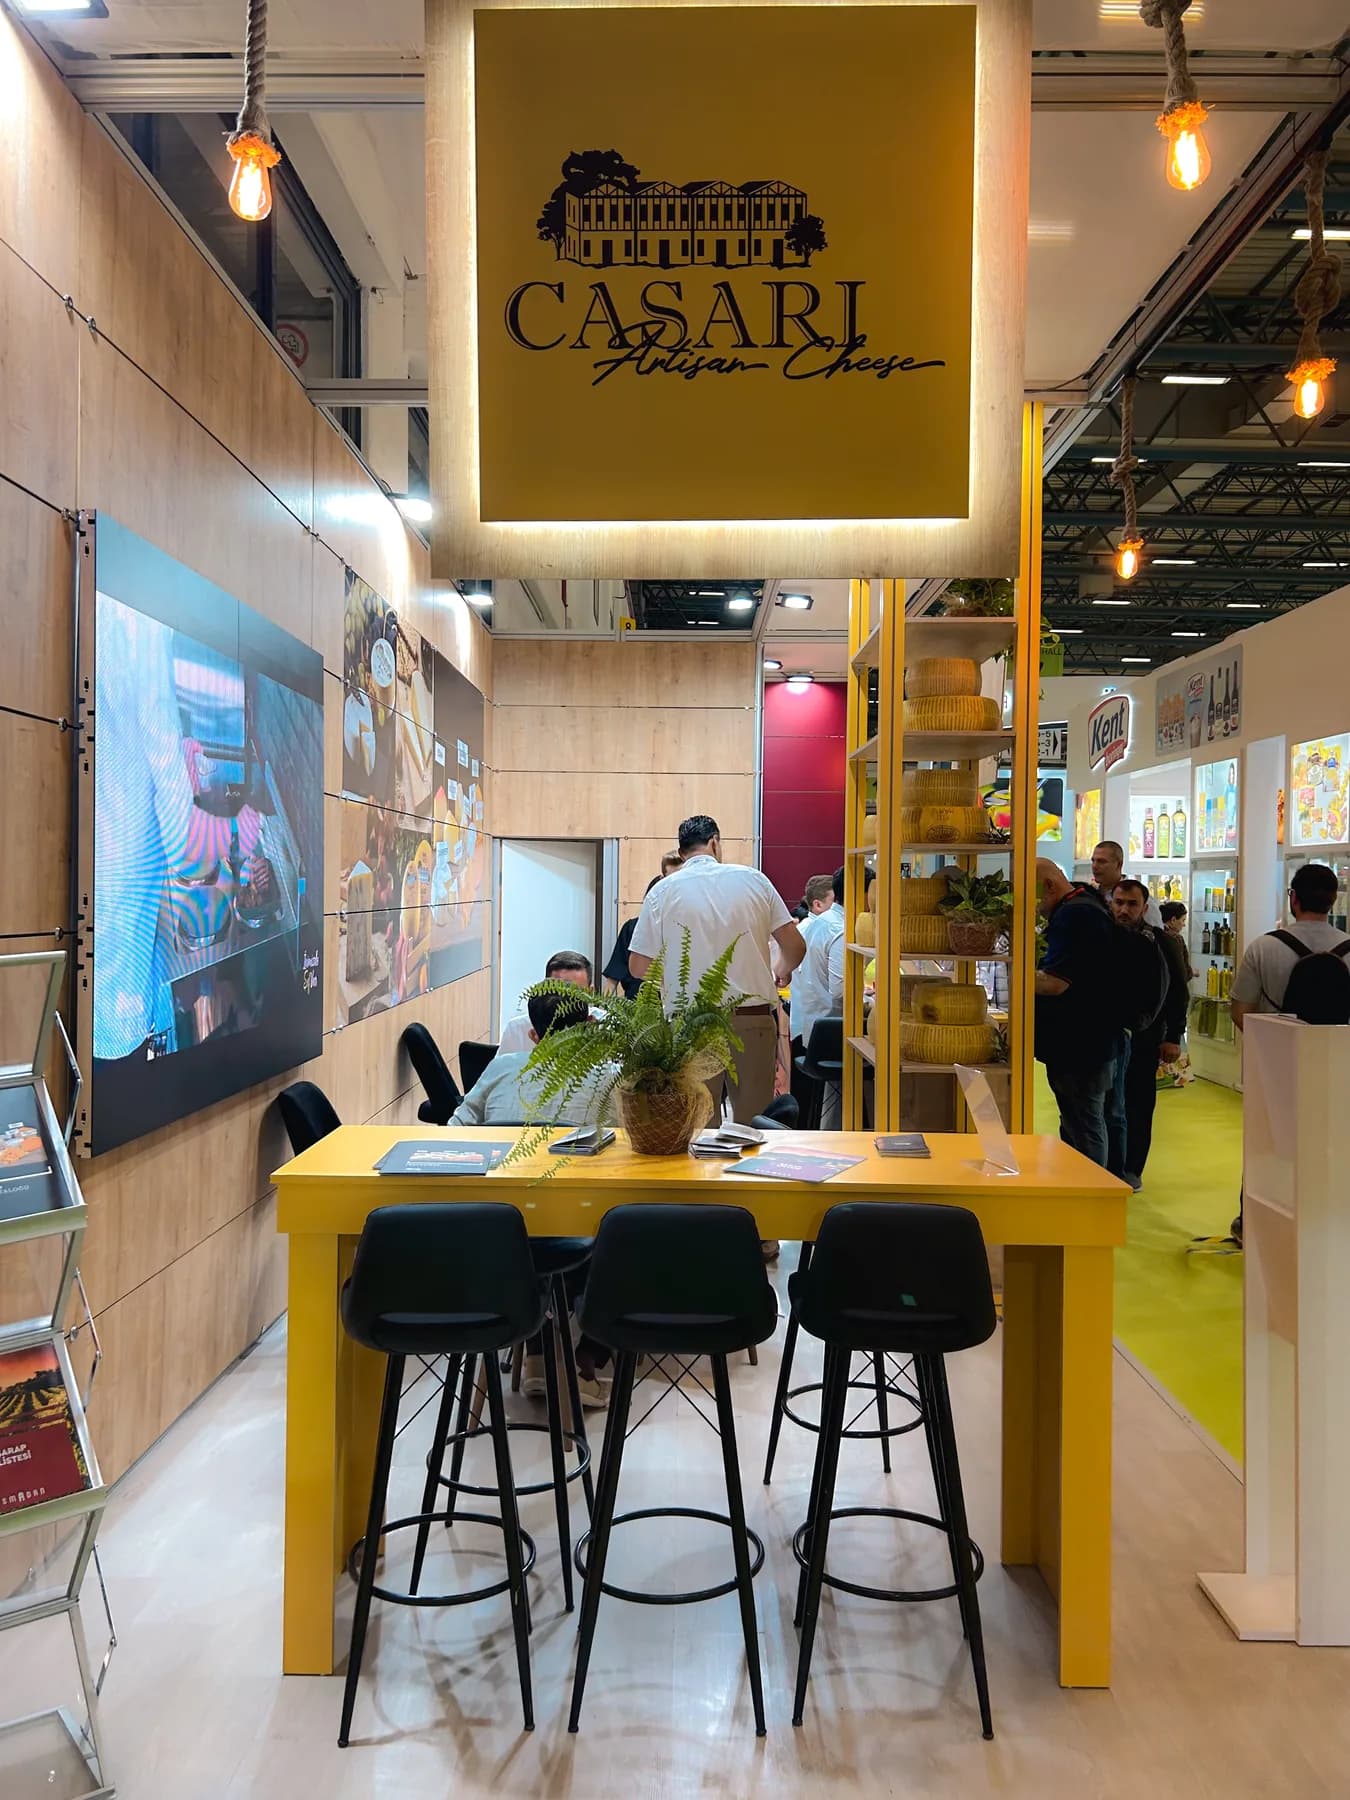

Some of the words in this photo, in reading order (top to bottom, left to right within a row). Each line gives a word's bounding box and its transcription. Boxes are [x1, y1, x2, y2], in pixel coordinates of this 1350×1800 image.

[504, 280, 866, 351] CASARI
[592, 320, 769, 386] Artisan
[783, 334, 946, 380] Cheese
[1091, 702, 1125, 756] Kent
[0, 1443, 27, 1457] ARAP
